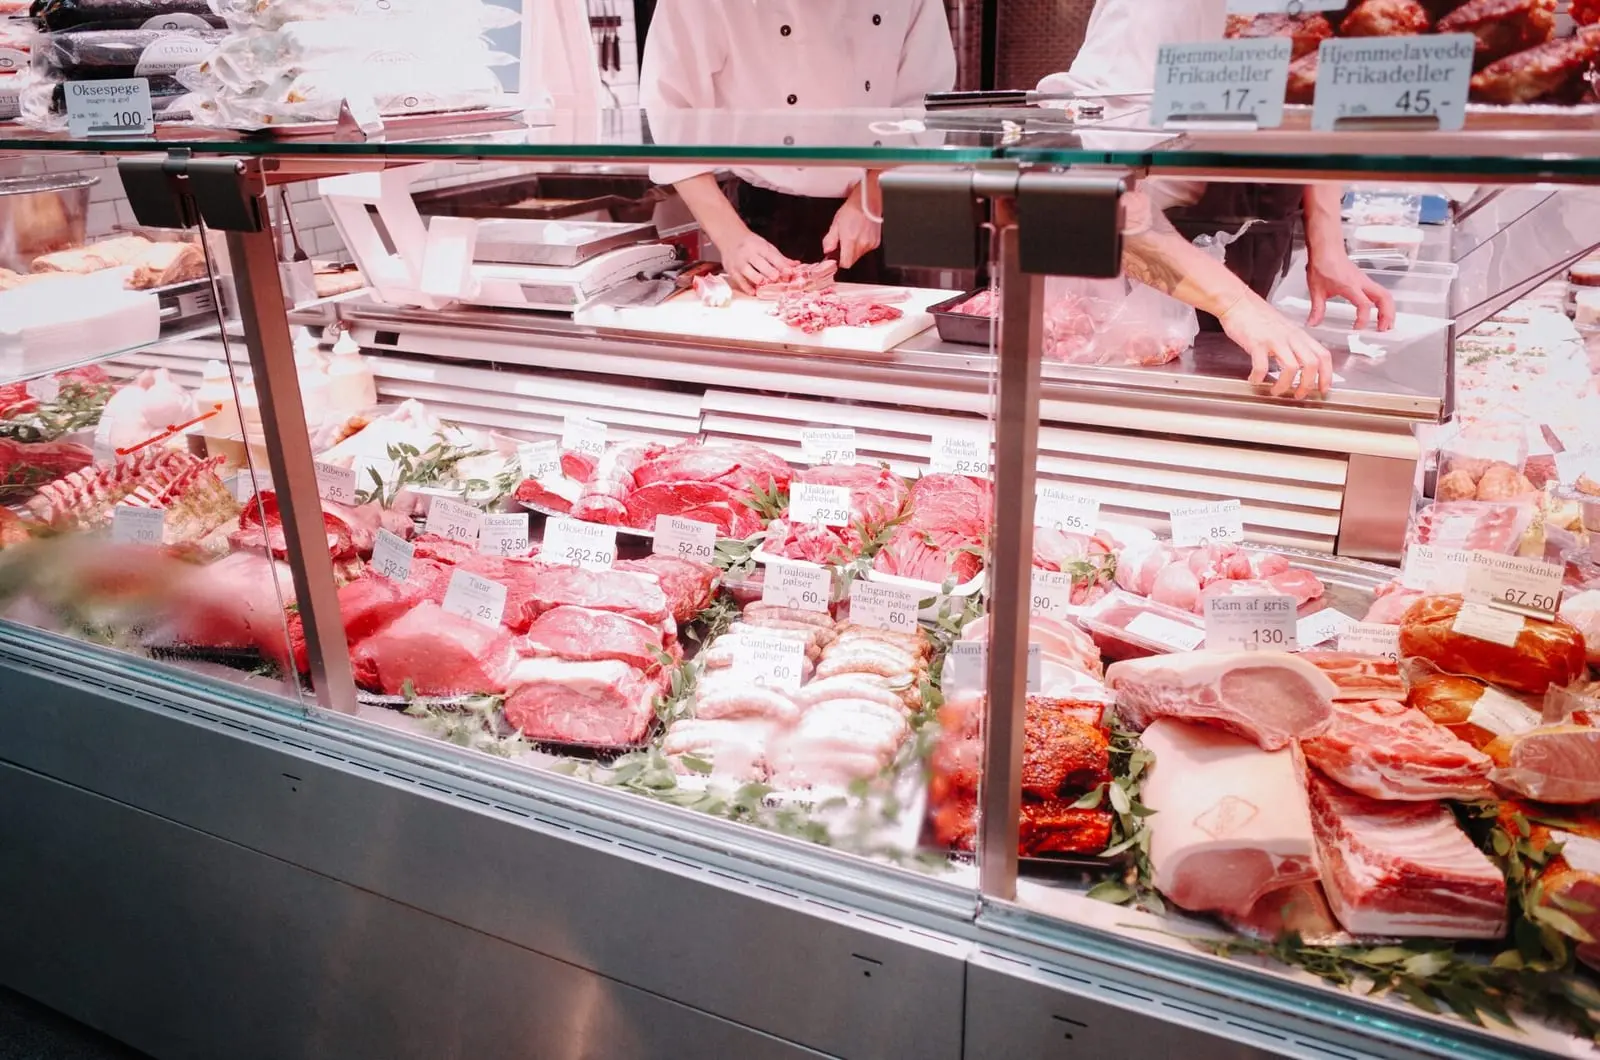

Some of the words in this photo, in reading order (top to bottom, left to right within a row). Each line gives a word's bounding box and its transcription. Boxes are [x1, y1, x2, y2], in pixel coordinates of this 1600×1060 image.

[1158, 44, 1289, 65] Hjemmelavede
[1321, 42, 1471, 64] Hjemmelavede
[1167, 66, 1272, 84] Frikadeller
[1333, 64, 1454, 84] Frikadeller
[72, 84, 141, 97] Oksespege
[1222, 89, 1267, 113] 17,-
[1395, 89, 1451, 115] 45,-
[113, 111, 152, 127] 100,-
[956, 460, 988, 473] 62,50
[816, 508, 848, 521] 62,50
[1066, 515, 1089, 529] 55,-
[558, 521, 604, 537] Oksefilet
[671, 519, 701, 533] Ribeye
[501, 538, 527, 550] 92,50
[678, 542, 711, 557] 52,50
[565, 547, 611, 564] 262,50
[777, 565, 821, 579] Toulouse
[1473, 553, 1561, 579] Bayonneskinke
[469, 577, 491, 592] Tatar
[782, 578, 812, 588] pølser
[860, 583, 912, 599] Ungarnske
[802, 591, 826, 605] 60,-
[887, 600, 917, 611] pølser
[1033, 596, 1059, 610] 90,-
[1211, 599, 1241, 611] Kam
[1246, 599, 1258, 611] af
[1263, 598, 1290, 612] gris
[1505, 588, 1554, 611] 67,50
[477, 605, 499, 621] 25,-
[889, 612, 915, 627] 60,-
[740, 636, 800, 654] Cumberland
[1252, 629, 1296, 646] 130,-
[773, 665, 798, 681] 60,-
